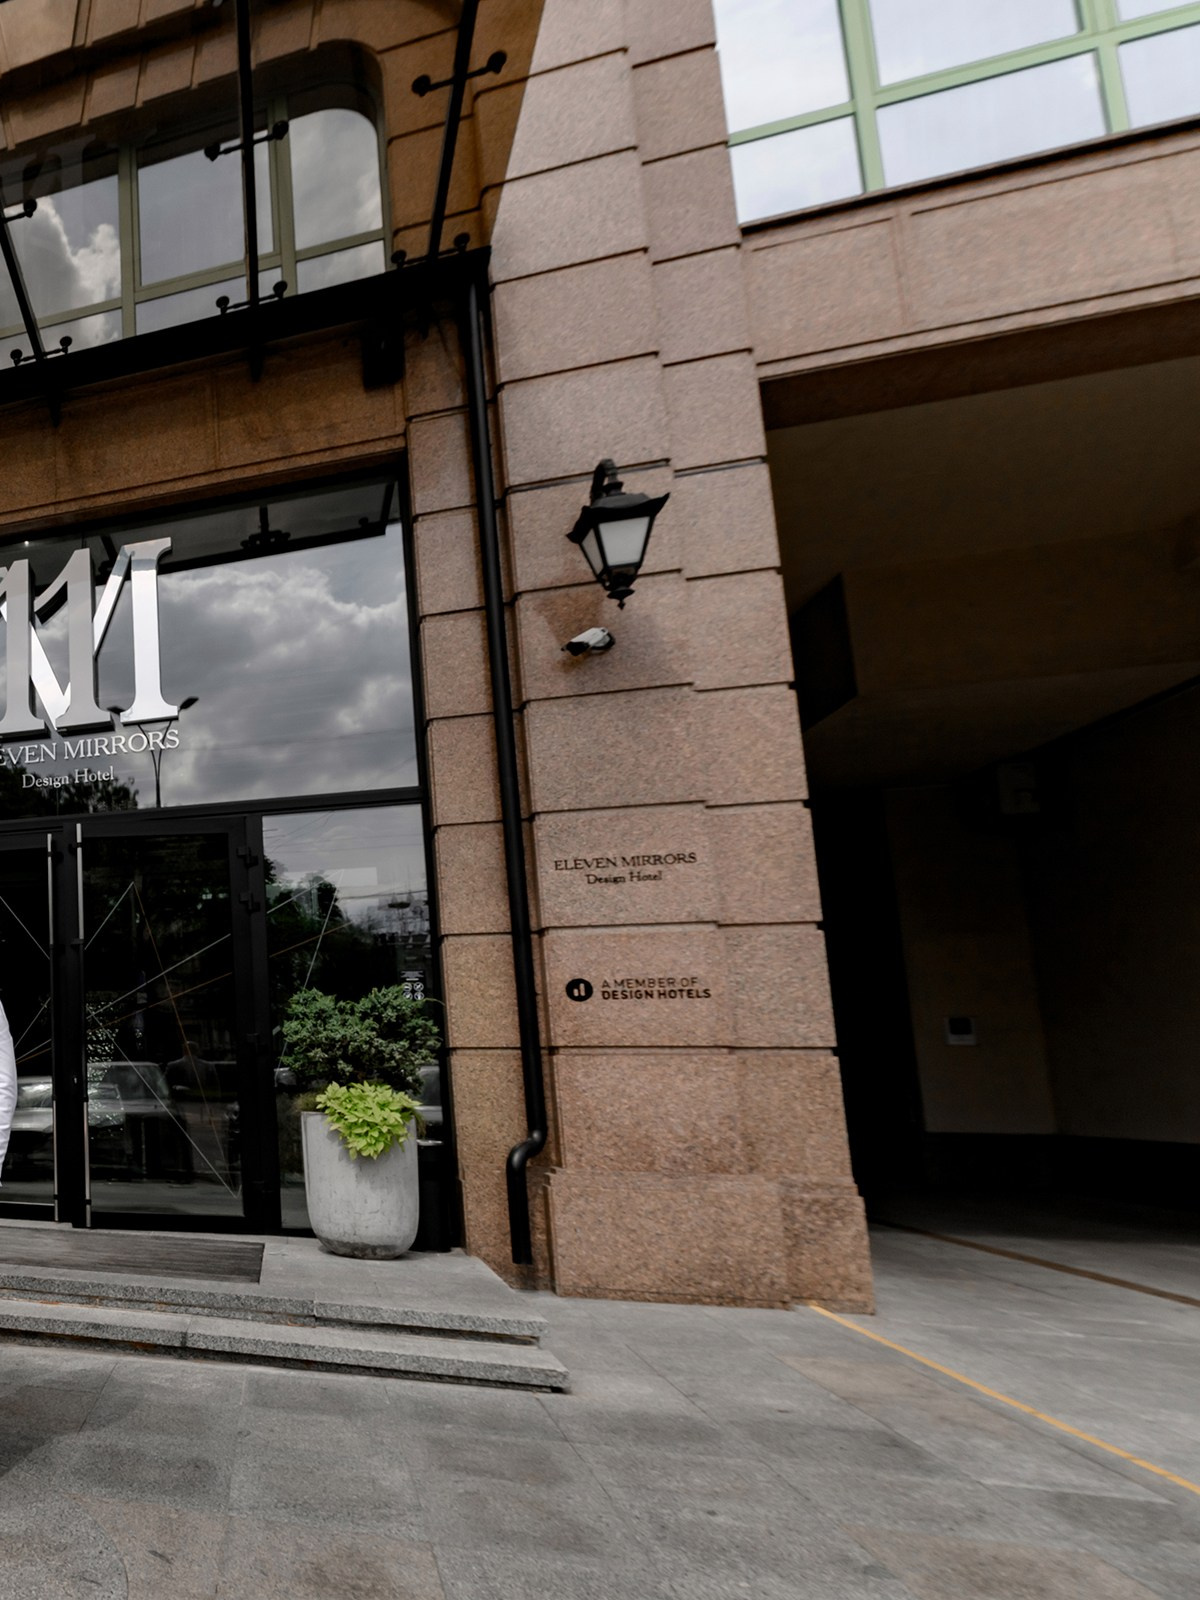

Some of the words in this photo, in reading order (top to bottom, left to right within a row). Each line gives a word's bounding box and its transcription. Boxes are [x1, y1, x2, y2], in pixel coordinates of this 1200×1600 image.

[63, 729, 180, 760] MIRRORS
[22, 773, 69, 789] Design
[75, 766, 114, 784] Hotel
[554, 856, 617, 871] ELEVEN
[621, 852, 697, 868] MIRRORS
[585, 873, 626, 885] Design
[629, 870, 662, 882] Hotel
[601, 979, 610, 989] A
[614, 978, 677, 989] MEMBER
[680, 977, 698, 987] OF
[602, 990, 654, 1000] DESIGN
[658, 989, 711, 999] HOTELS
